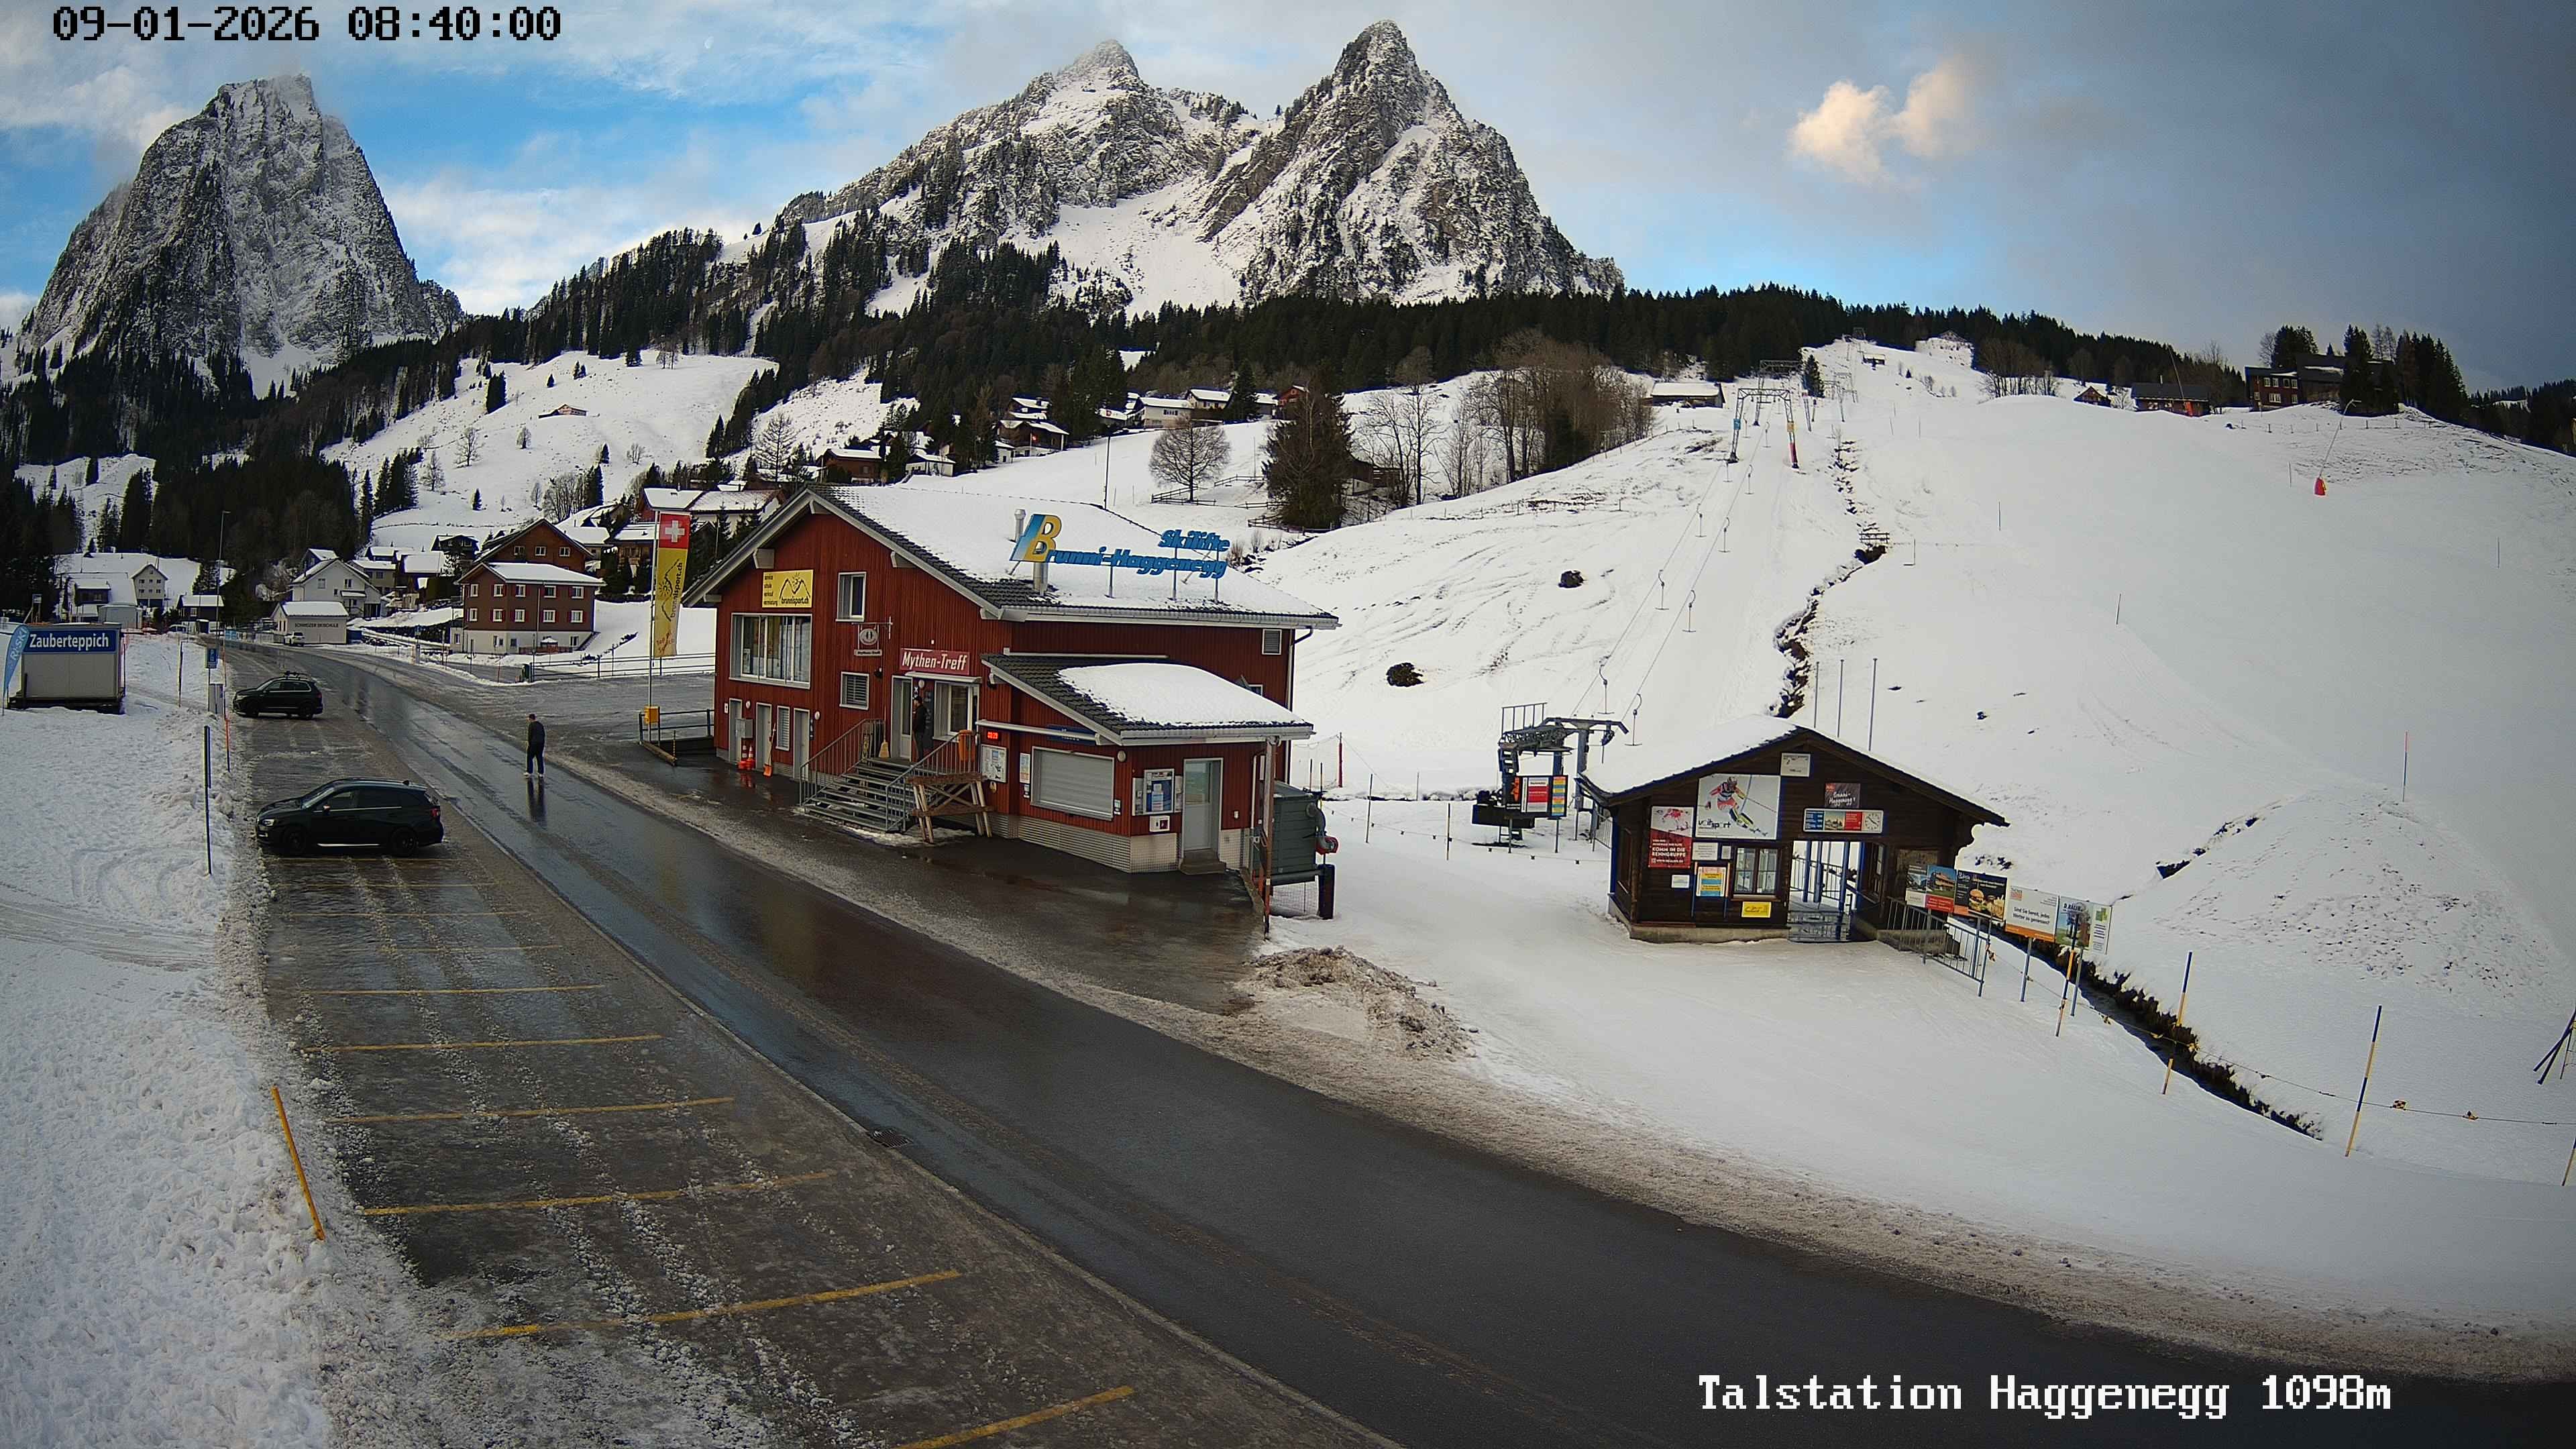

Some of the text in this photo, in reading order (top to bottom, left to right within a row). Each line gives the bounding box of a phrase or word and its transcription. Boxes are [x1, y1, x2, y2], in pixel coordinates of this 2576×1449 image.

[1158, 529, 1230, 552] Skilifte
[670, 562, 683, 618] brunnisport.ch
[781, 596, 810, 606] brunnisport.ch
[30, 633, 109, 651] Zauberteppich
[902, 651, 968, 671] Mythen-Treff
